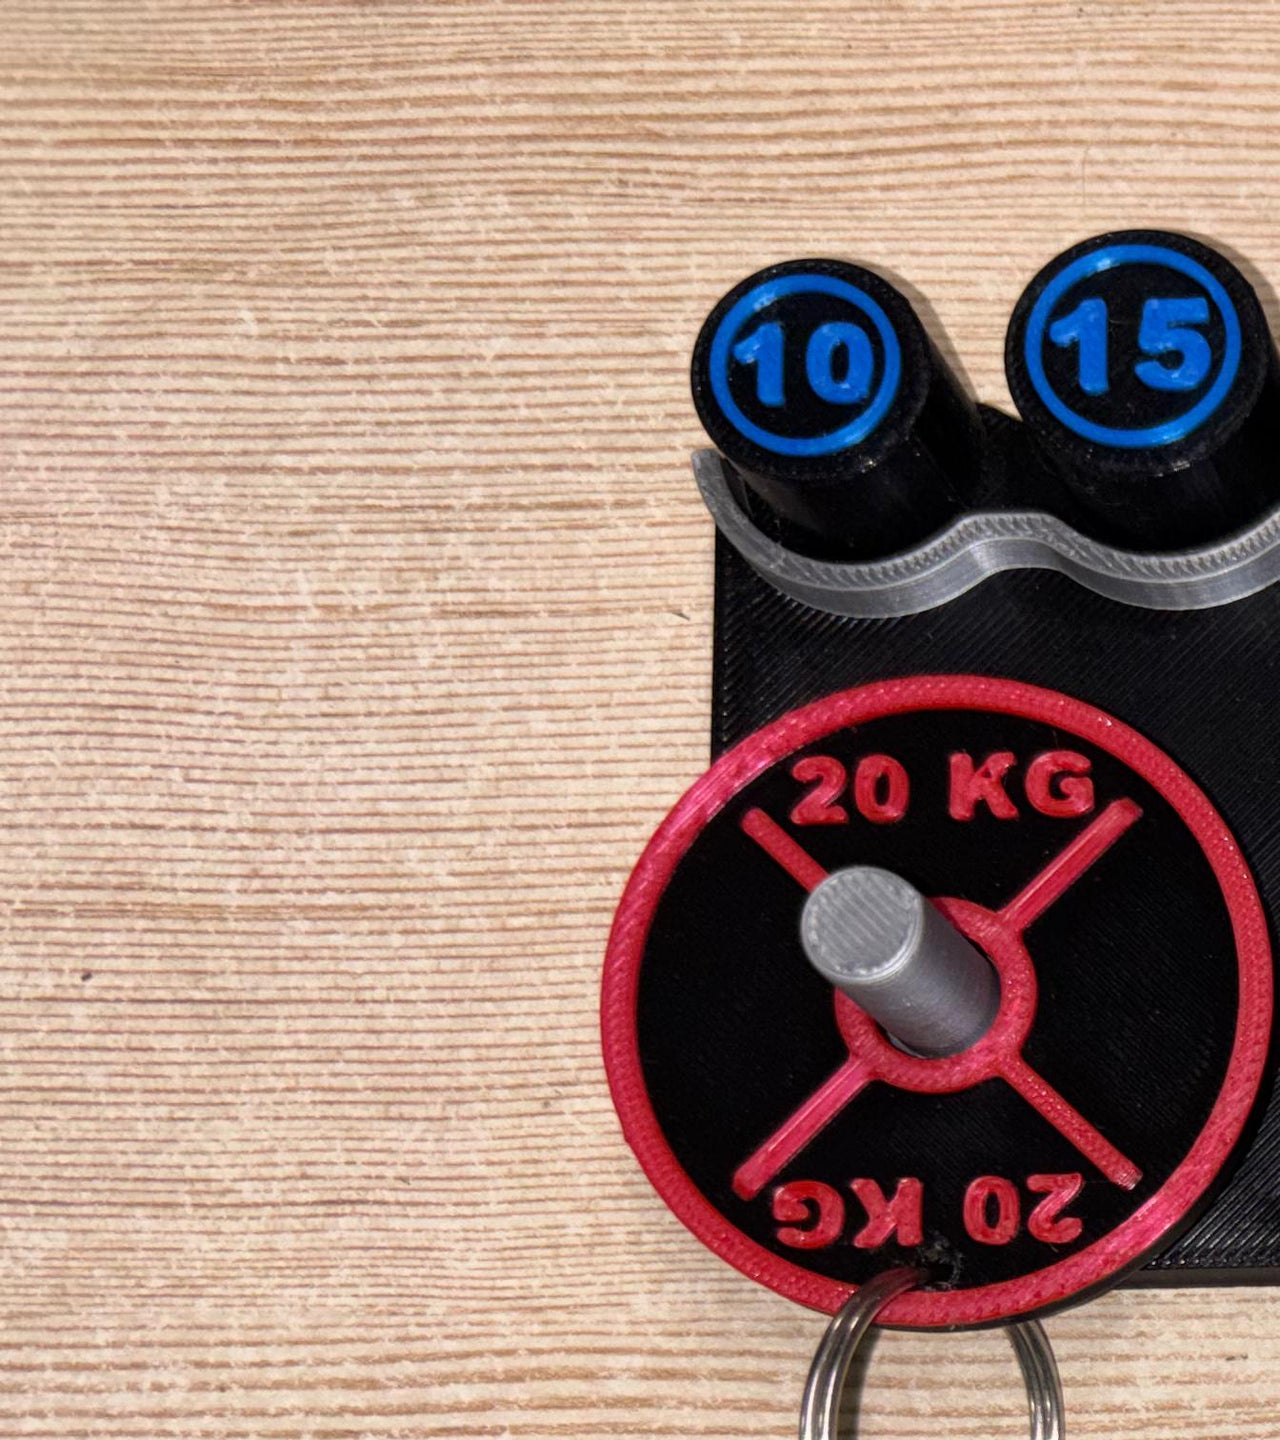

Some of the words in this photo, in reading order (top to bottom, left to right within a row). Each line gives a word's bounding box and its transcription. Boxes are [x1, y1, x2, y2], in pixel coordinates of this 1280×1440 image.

[731, 318, 877, 409] 10
[1048, 296, 1212, 395] 15
[789, 753, 910, 826] 20
[948, 749, 1095, 821] KG
[772, 1176, 923, 1250] KG
[962, 1172, 1085, 1246] 20
